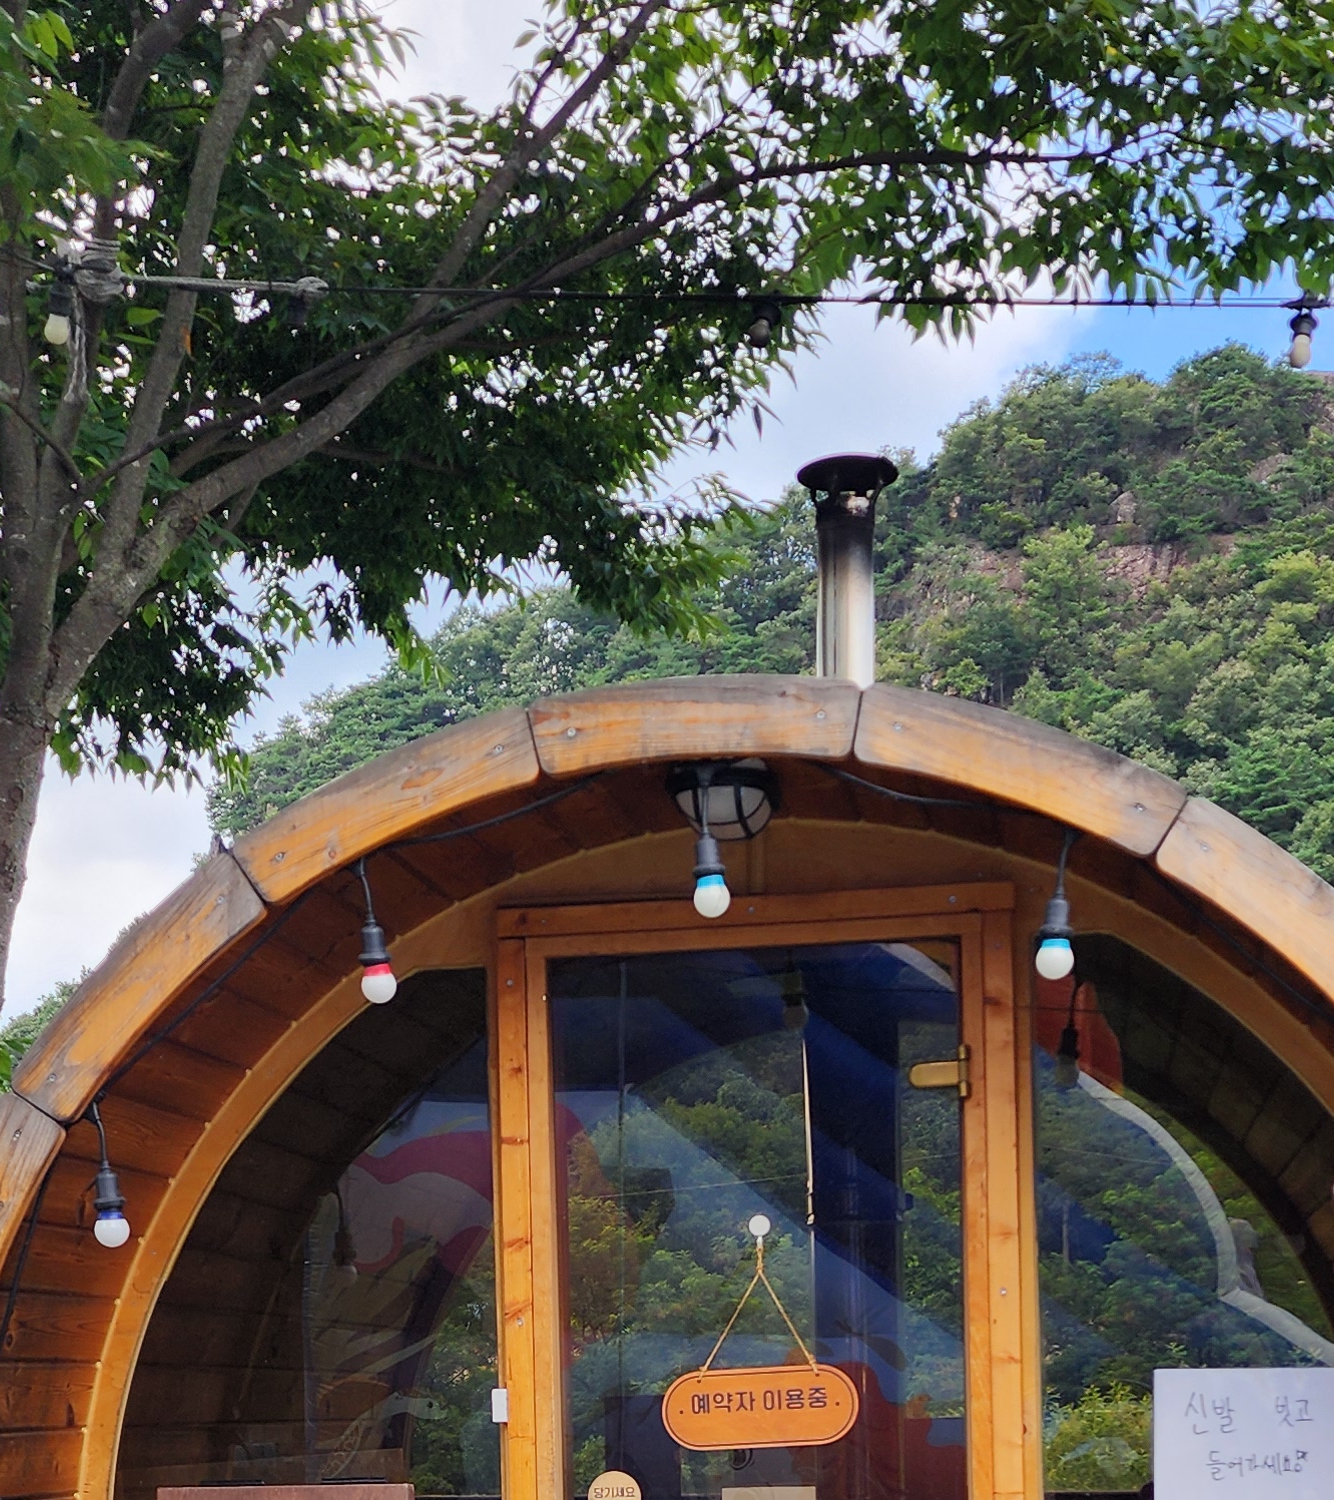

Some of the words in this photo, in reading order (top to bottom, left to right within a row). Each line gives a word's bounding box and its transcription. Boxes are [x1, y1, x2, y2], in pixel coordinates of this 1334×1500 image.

[691, 1391, 755, 1415] 예약자
[762, 1387, 828, 1412] 이용중
[1184, 1391, 1237, 1435] 신발
[1273, 1394, 1314, 1427] 벗고
[593, 1486, 636, 1499] 당기세요
